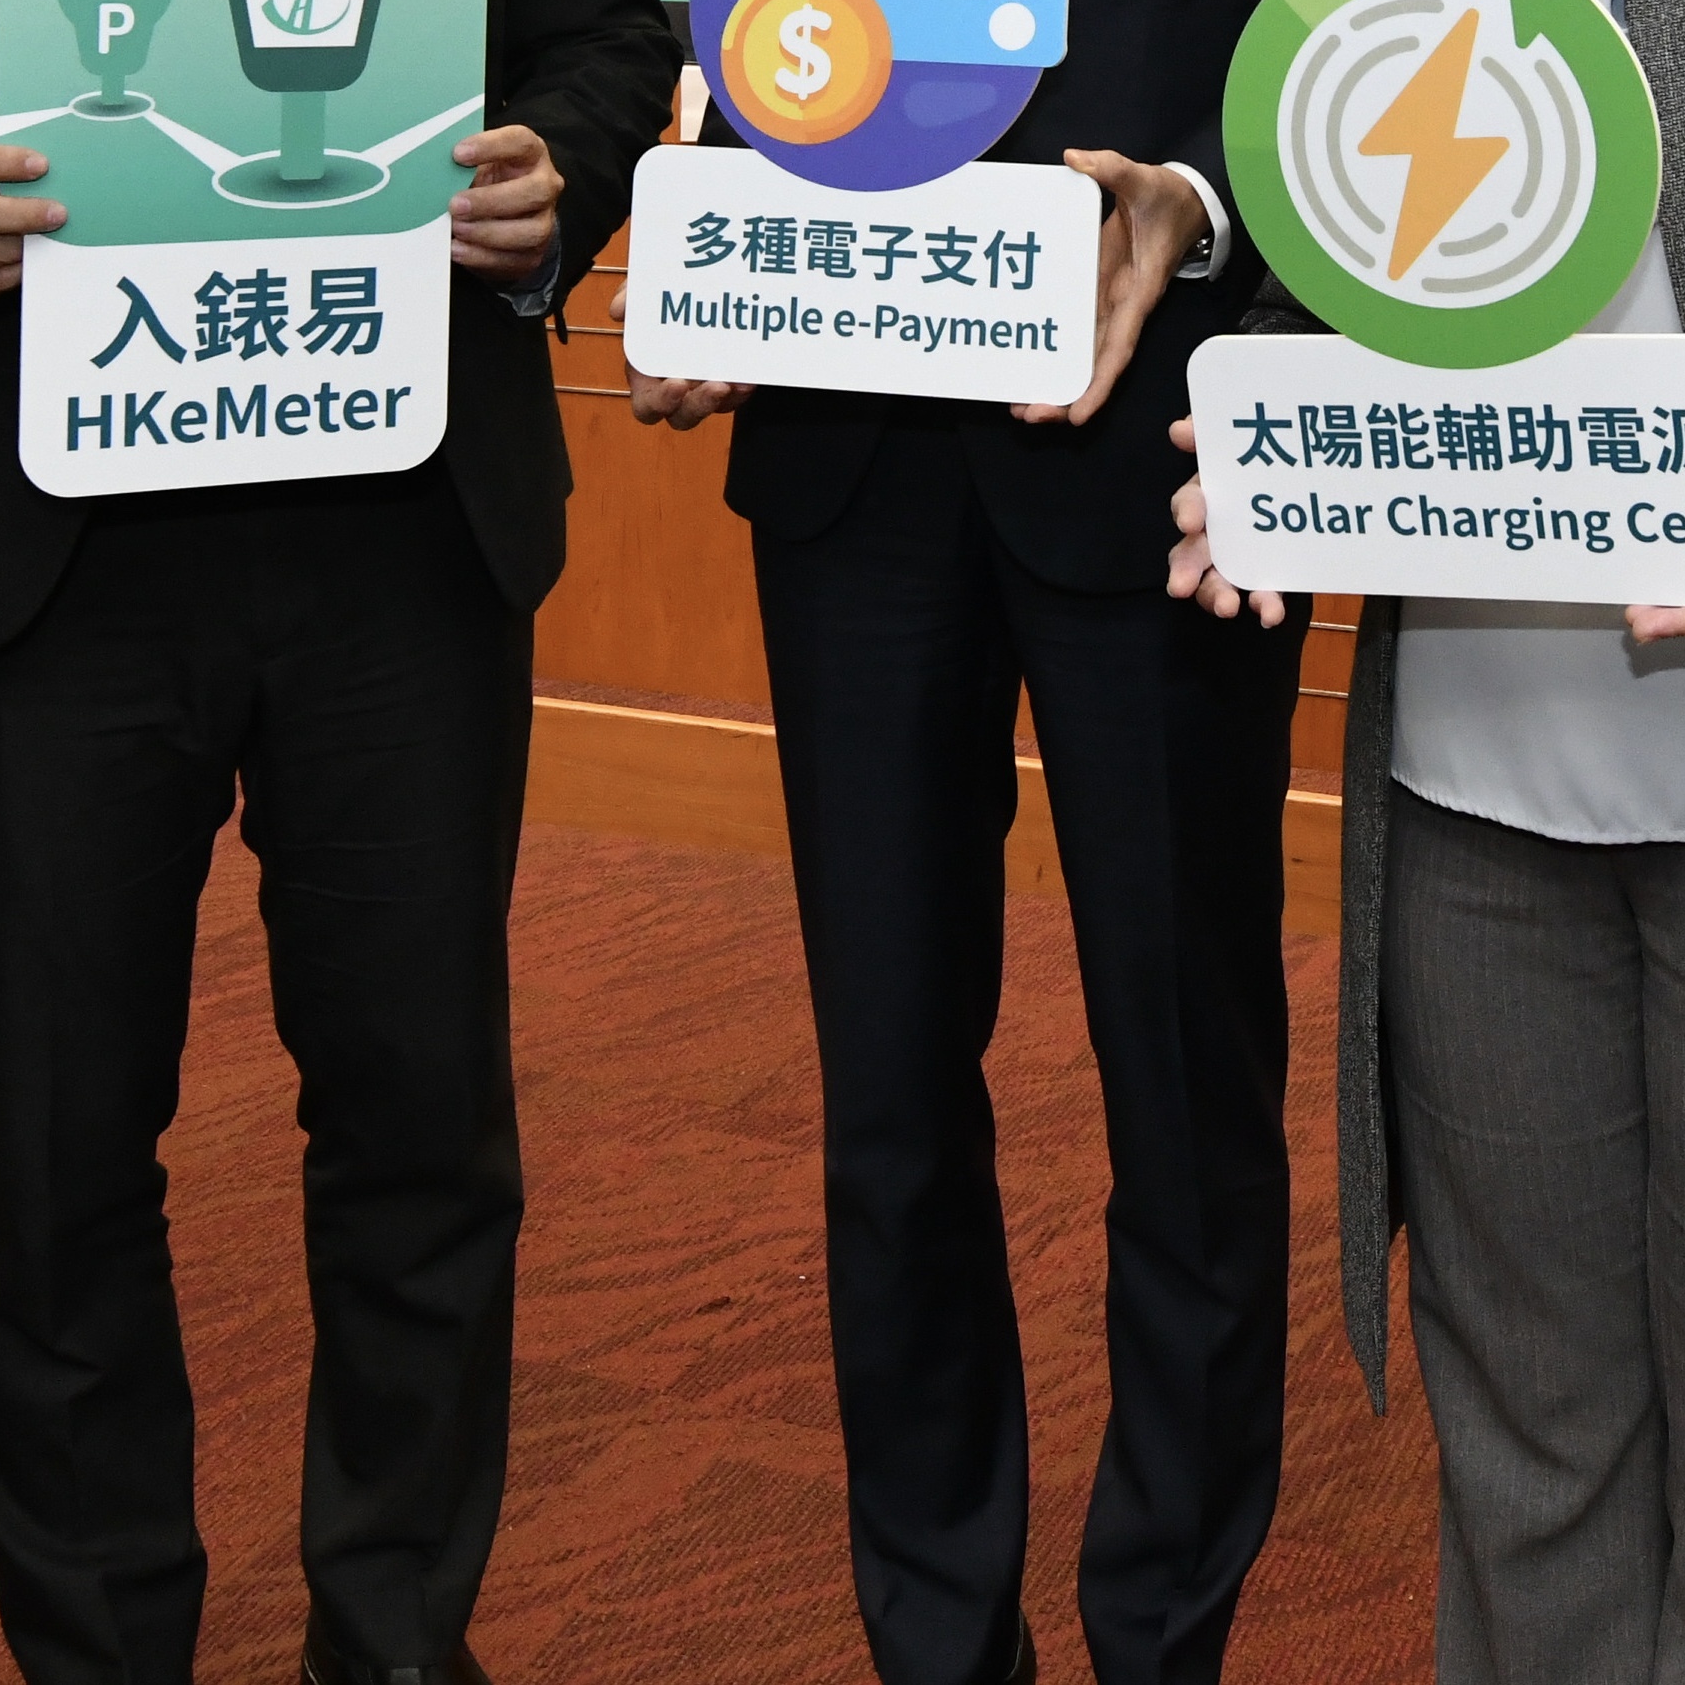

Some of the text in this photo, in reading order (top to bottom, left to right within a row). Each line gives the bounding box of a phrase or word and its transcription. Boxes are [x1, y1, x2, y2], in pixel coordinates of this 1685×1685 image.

[98, 4, 135, 55] P
[683, 212, 1041, 291] 多種電子支付
[90, 266, 385, 369] 入錶易
[660, 290, 1058, 353] Multiple e-Payment
[66, 381, 411, 451] HKeMeter
[1251, 493, 1372, 534] Solar
[1388, 496, 1614, 553] Charging
